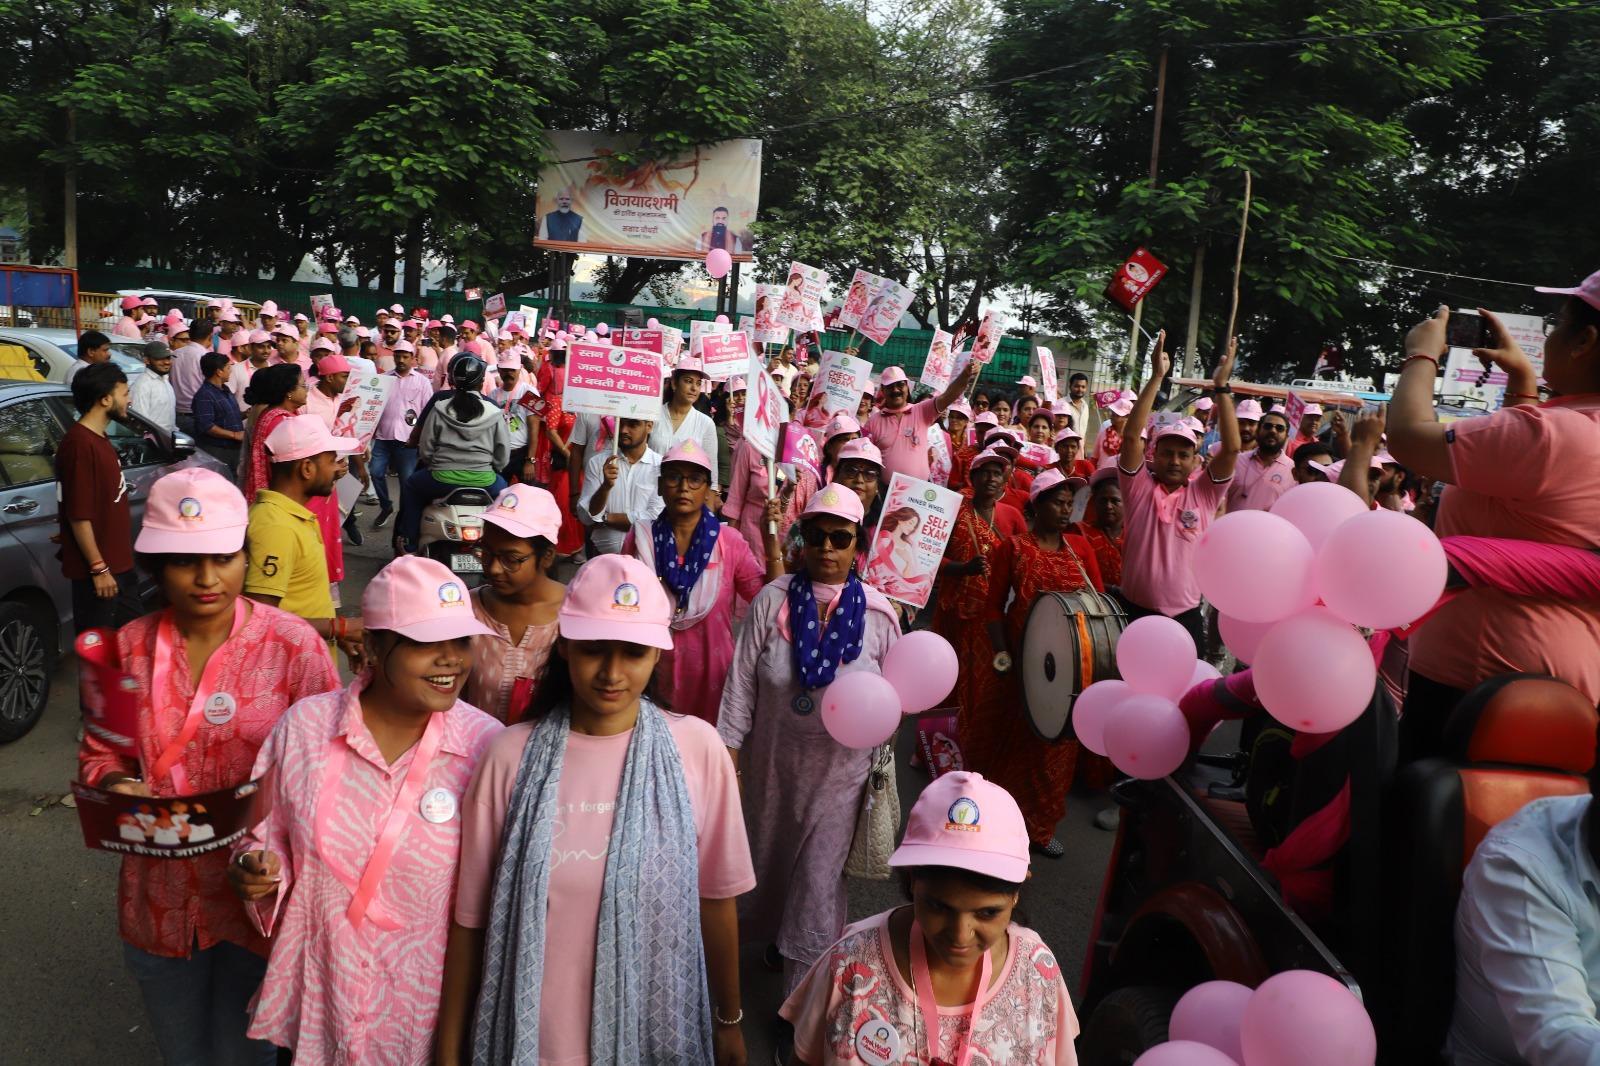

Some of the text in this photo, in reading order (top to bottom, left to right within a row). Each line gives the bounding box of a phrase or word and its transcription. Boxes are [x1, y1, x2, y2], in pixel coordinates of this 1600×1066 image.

[603, 188, 679, 214] विजयादशमी
[578, 349, 657, 367] स्तन कैंसर
[577, 362, 604, 373] जल्द
[571, 374, 583, 384] से
[585, 377, 616, 388] बचती
[616, 379, 626, 390] है
[828, 377, 851, 388] TODAY
[908, 497, 944, 514] INNER WHEEL
[927, 515, 949, 529] SELF
[921, 524, 948, 542] EXAM
[918, 541, 942, 556] YOUR LIFE
[262, 555, 279, 577] 5
